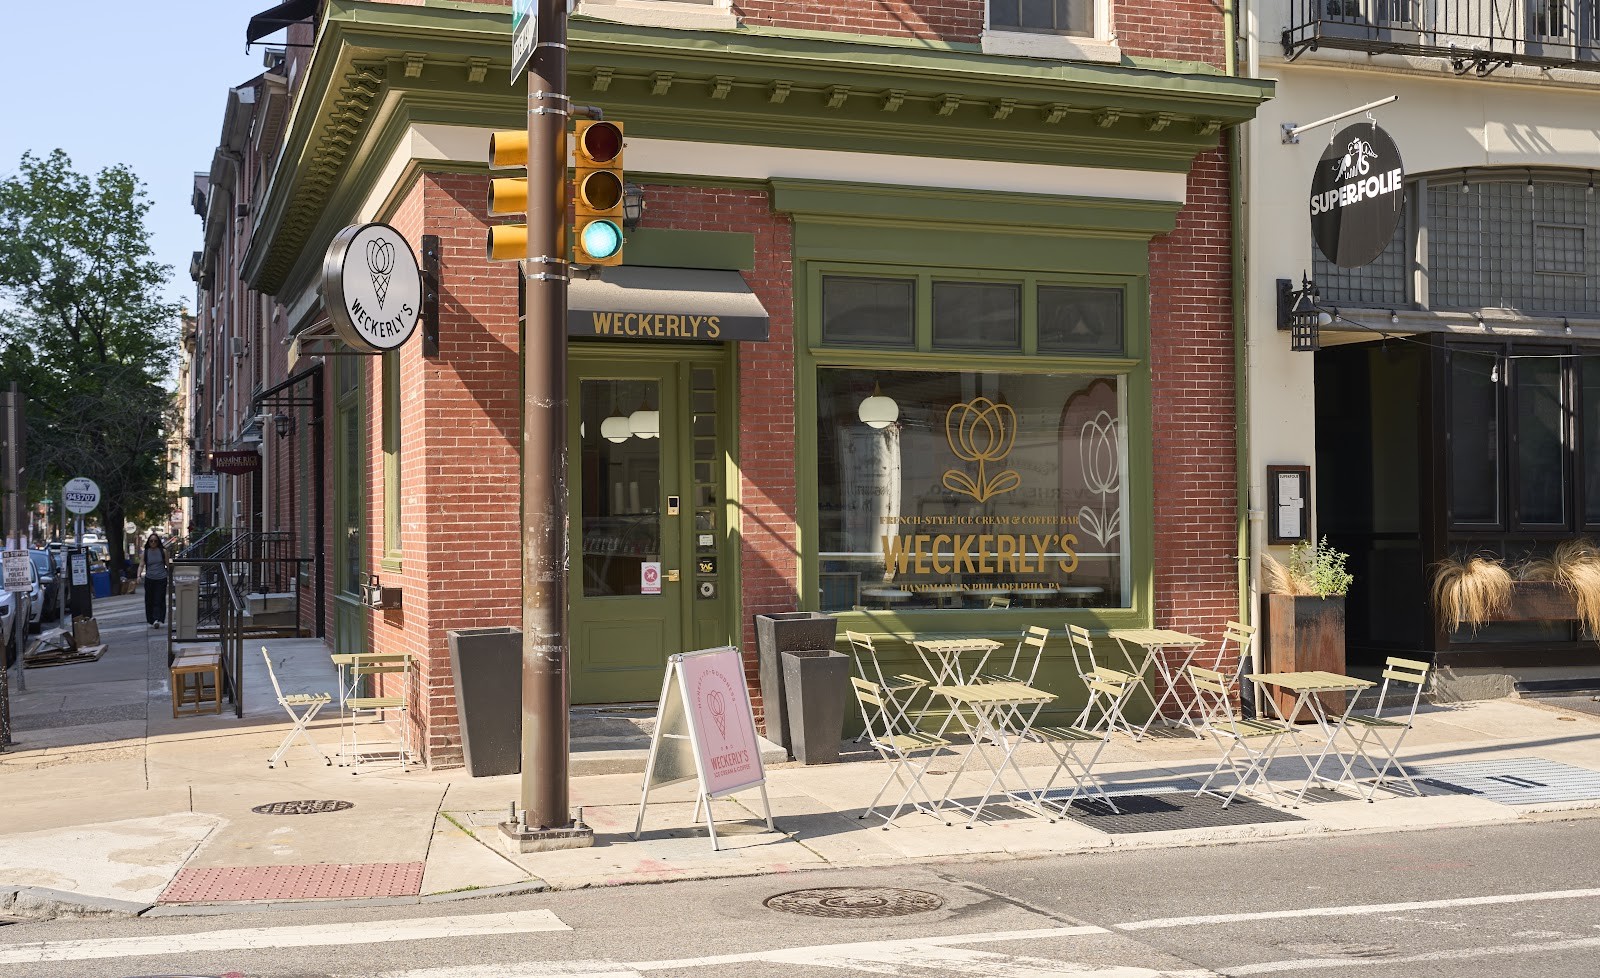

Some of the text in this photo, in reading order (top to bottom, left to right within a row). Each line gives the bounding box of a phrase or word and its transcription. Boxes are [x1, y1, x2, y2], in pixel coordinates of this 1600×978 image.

[1310, 168, 1402, 215] SUPERFOLIE
[351, 298, 413, 338] WECKERLY'S
[593, 312, 721, 339] WECKERLY'S
[216, 456, 242, 466] JASMINE
[67, 493, 94, 501] 943707
[880, 515, 1079, 525] FRENCH-STYLE ICE CREAM & COFFEE BAR
[881, 533, 1079, 574] WECKERLY'S
[900, 583, 957, 593] HANDMADE
[960, 583, 970, 592] IN
[711, 750, 749, 770] WECKERLY'S
